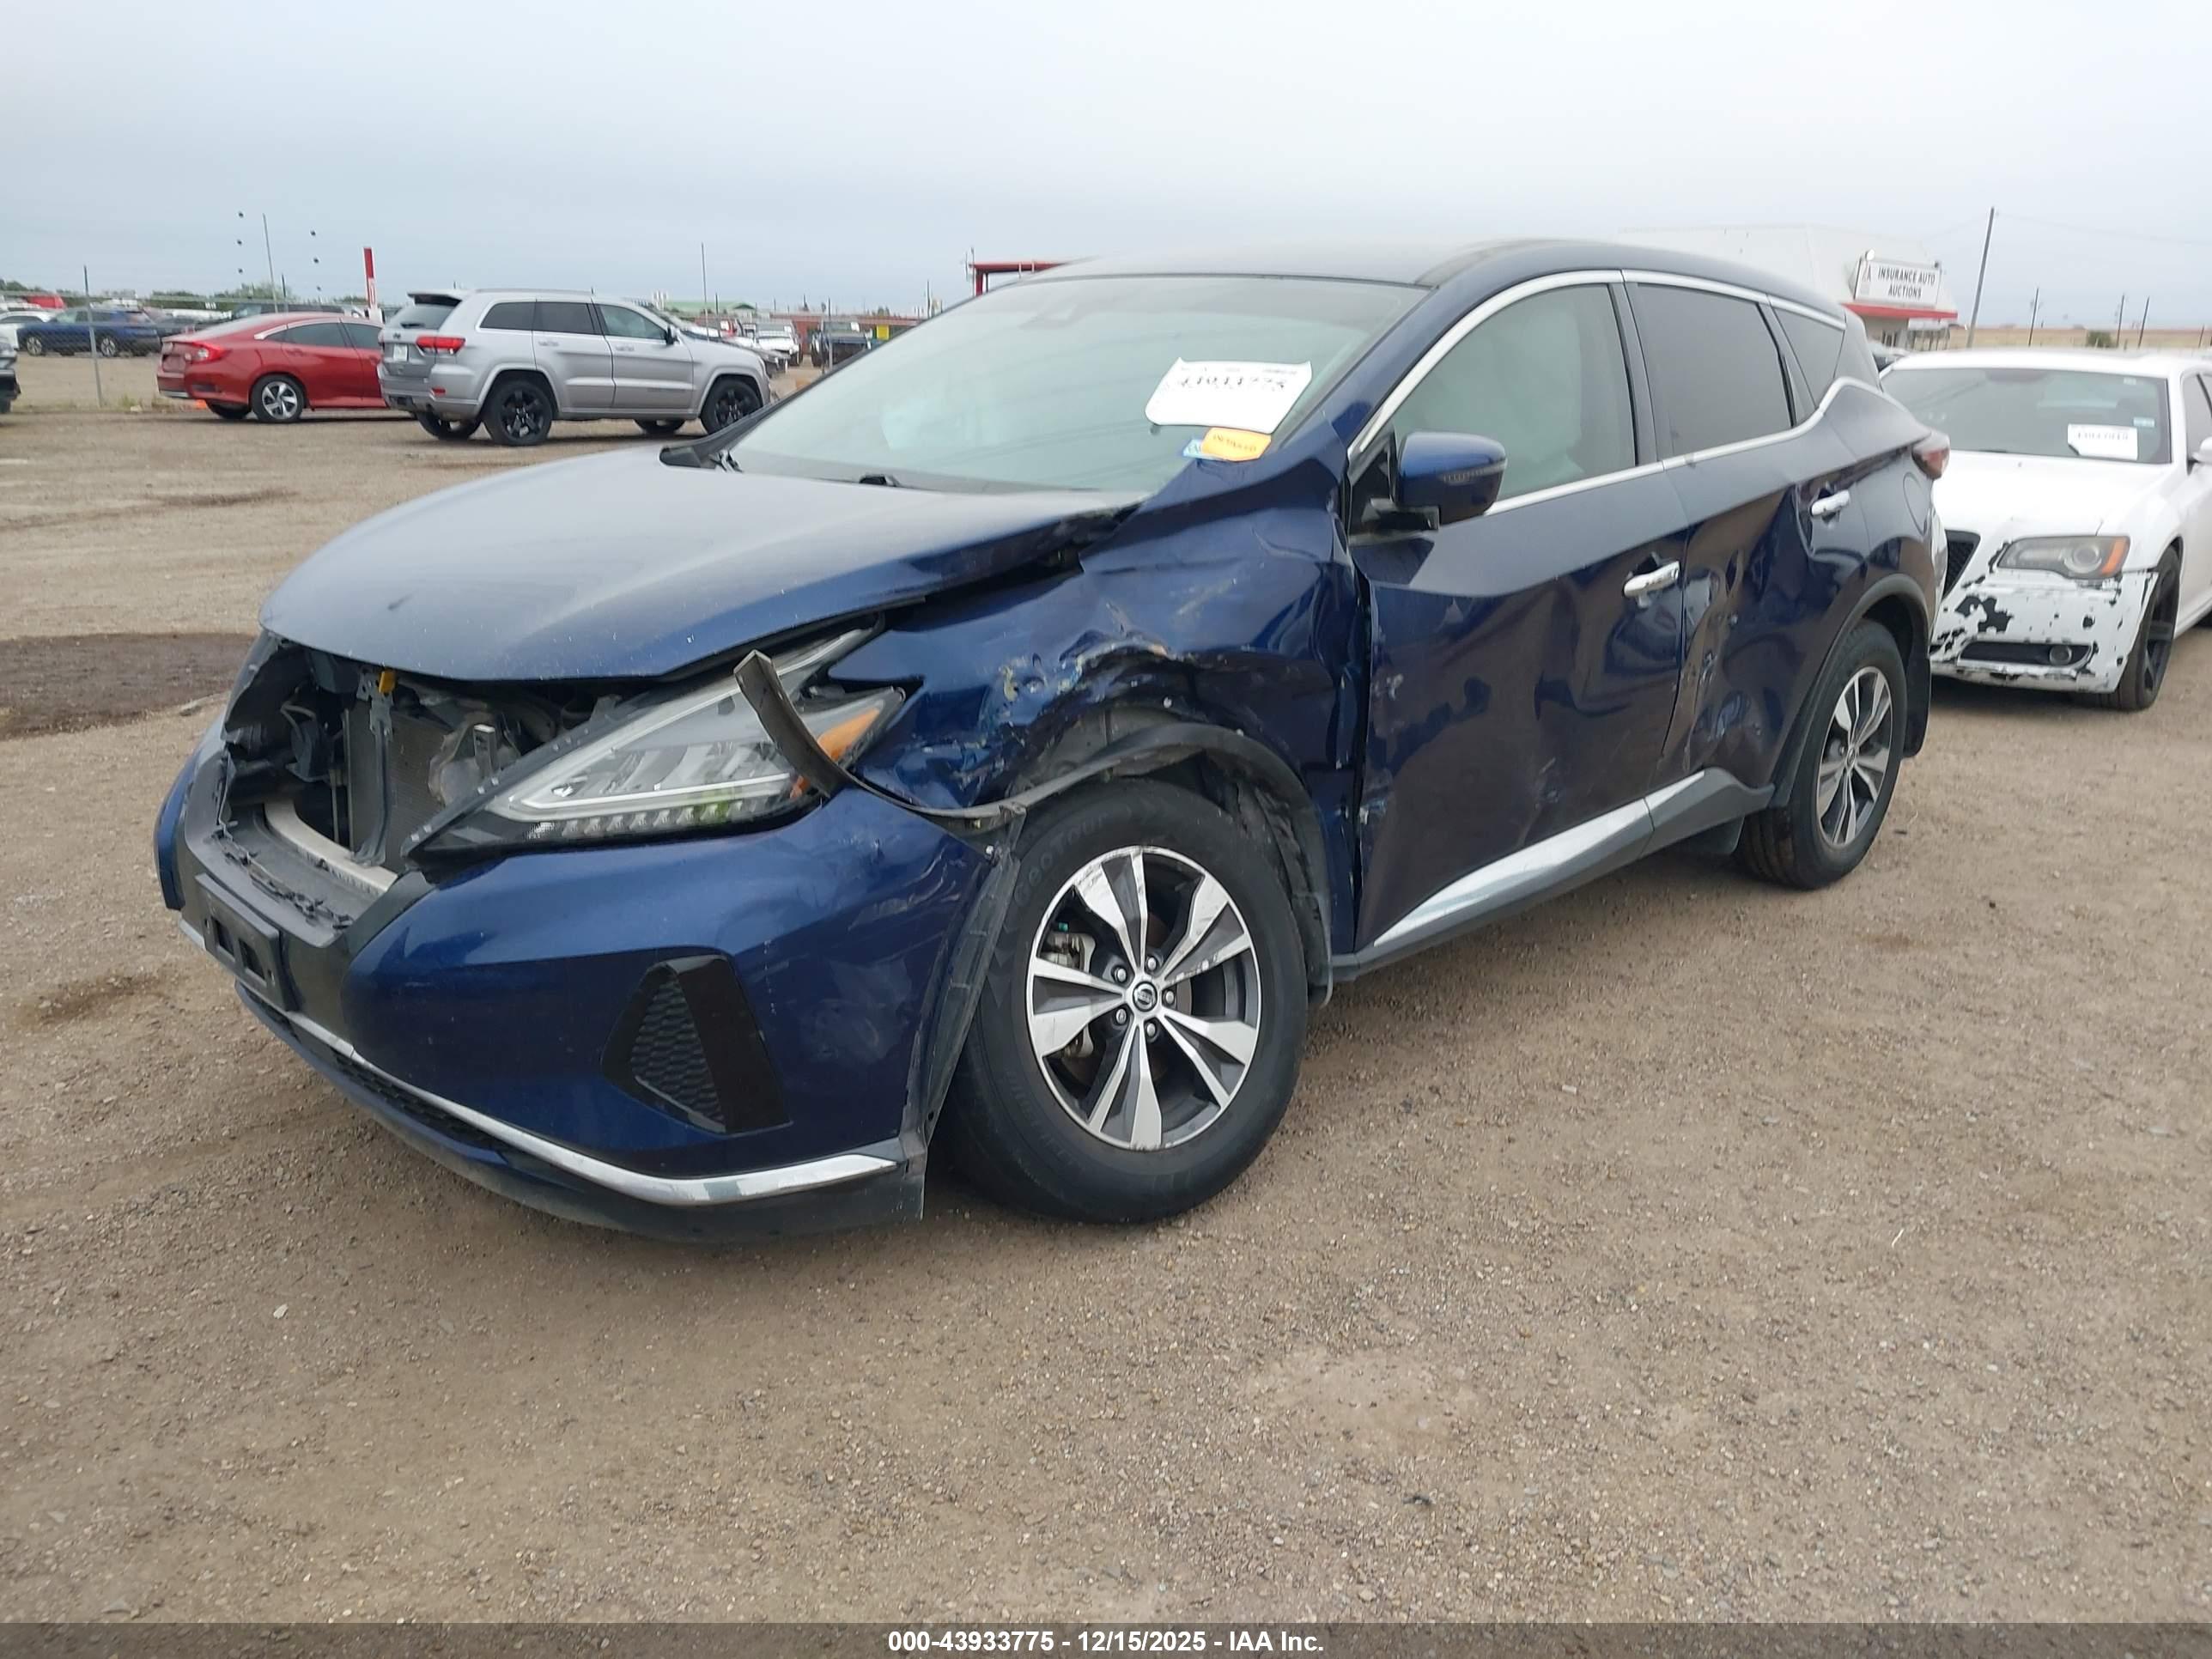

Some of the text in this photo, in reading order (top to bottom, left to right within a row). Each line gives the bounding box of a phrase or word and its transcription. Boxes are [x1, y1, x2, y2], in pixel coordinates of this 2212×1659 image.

[1878, 266, 1917, 283] INSURANCE
[1918, 270, 1936, 286] AUTO
[1888, 283, 1922, 299] AUCTIONS
